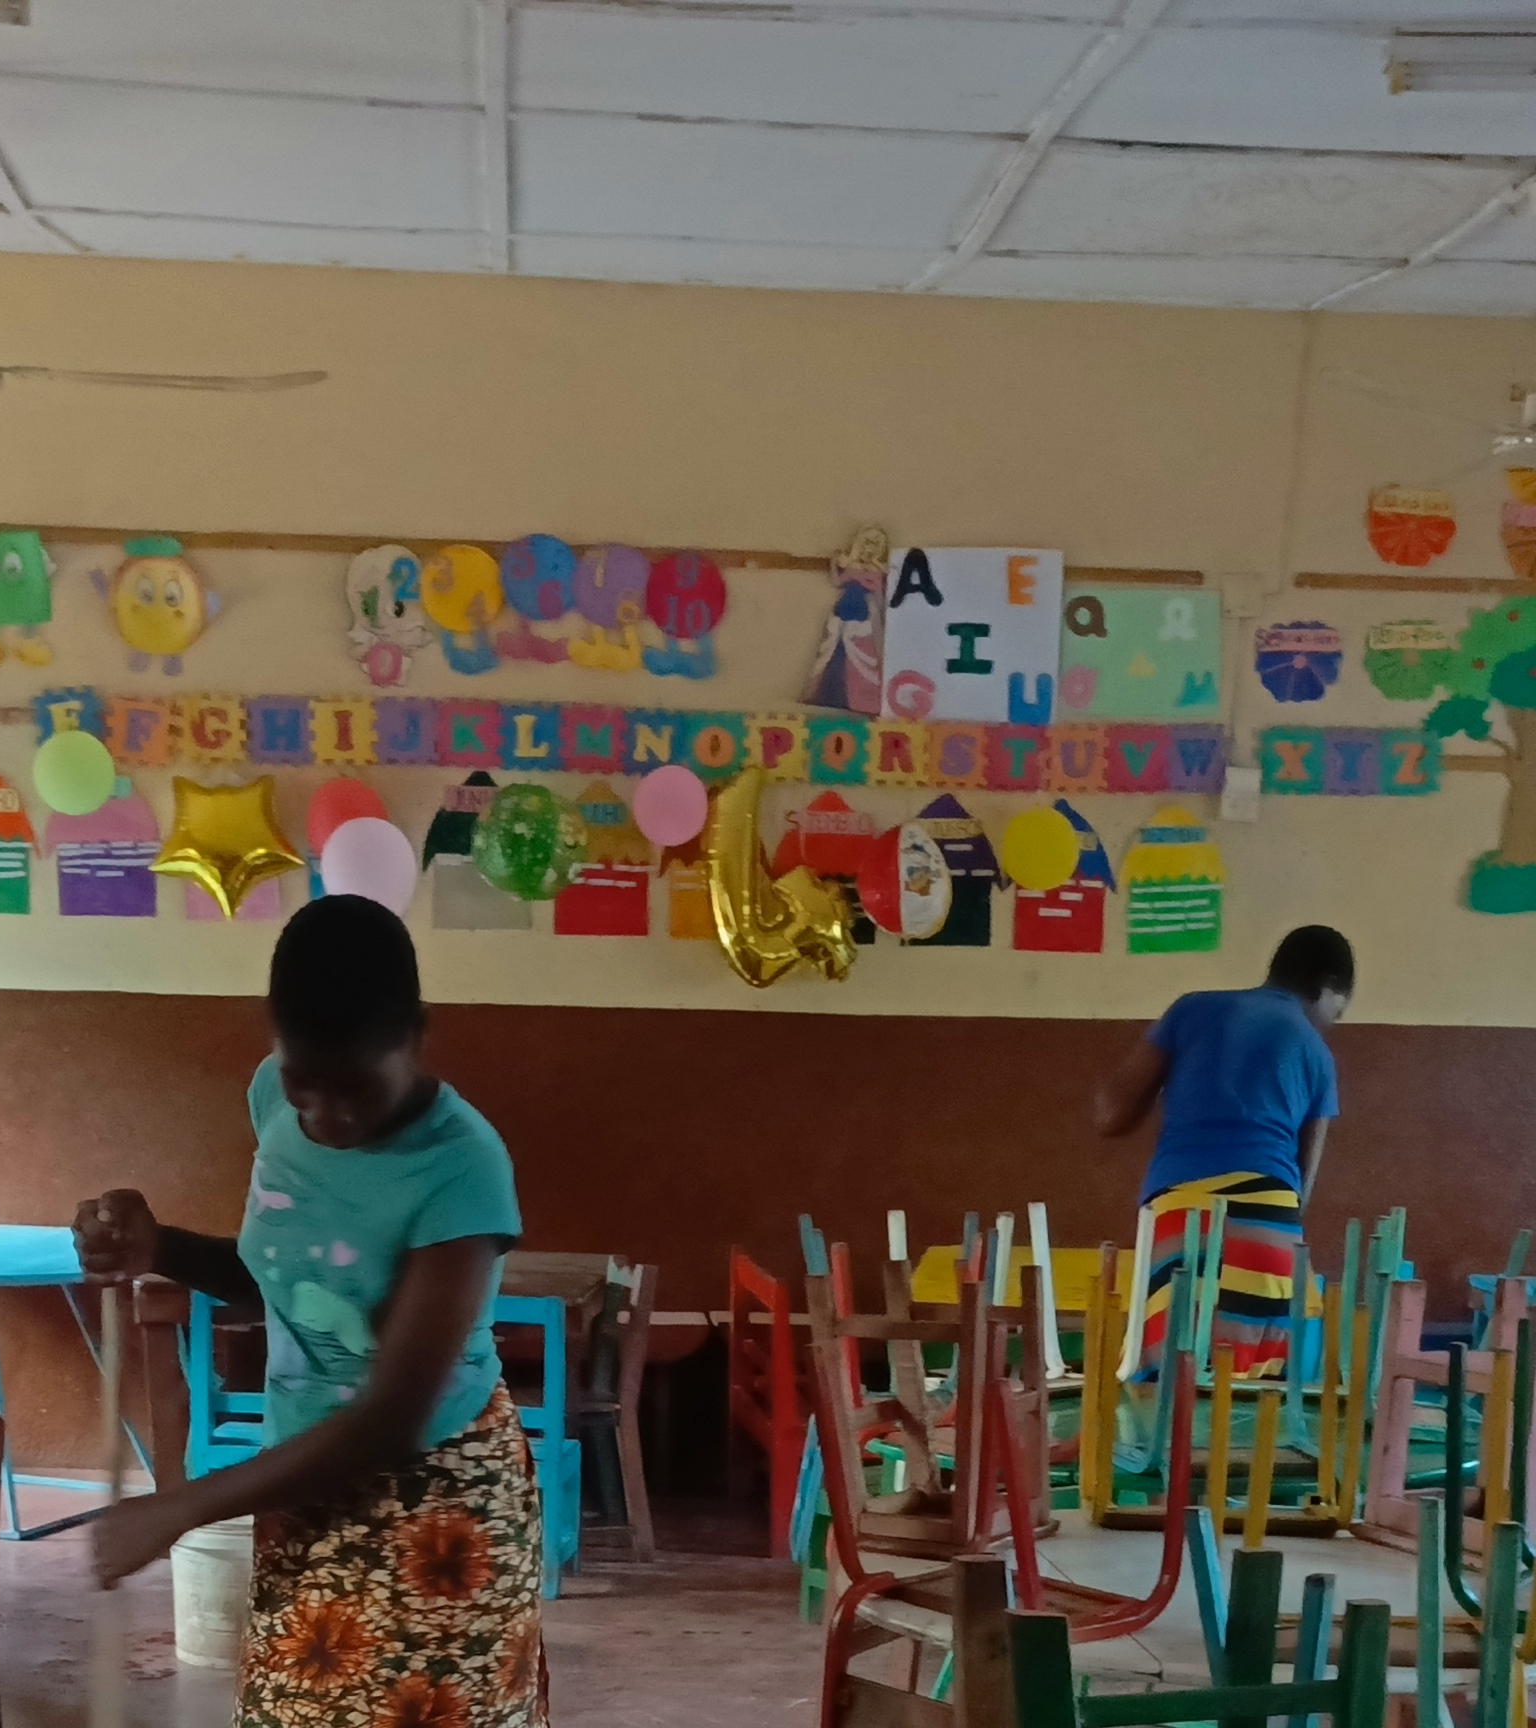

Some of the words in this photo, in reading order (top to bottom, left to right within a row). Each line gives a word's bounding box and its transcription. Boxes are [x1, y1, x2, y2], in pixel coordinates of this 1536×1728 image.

[390, 556, 419, 602] 2
[676, 553, 701, 588] 9
[890, 547, 944, 608] A
[1007, 555, 1039, 606] E
[666, 594, 711, 635] 10
[946, 622, 996, 674] I
[1008, 671, 1053, 727] U
[124, 709, 161, 752] F
[190, 707, 232, 750] G
[261, 708, 301, 752] H
[333, 709, 356, 752] I
[390, 709, 422, 752] J
[451, 714, 487, 753] K
[513, 714, 551, 758] L
[574, 722, 613, 758] M
[632, 724, 674, 763] N
[693, 726, 737, 769] O
[759, 726, 795, 770] P
[822, 730, 857, 773] Q
[877, 731, 917, 774] R
[939, 734, 978, 778] S
[1001, 738, 1038, 781] T
[1060, 740, 1100, 779] U
[1119, 740, 1158, 781] V
[1175, 738, 1217, 777] W
[1273, 741, 1312, 781] X
[1333, 741, 1373, 781] Y
[1392, 742, 1429, 785] Z
